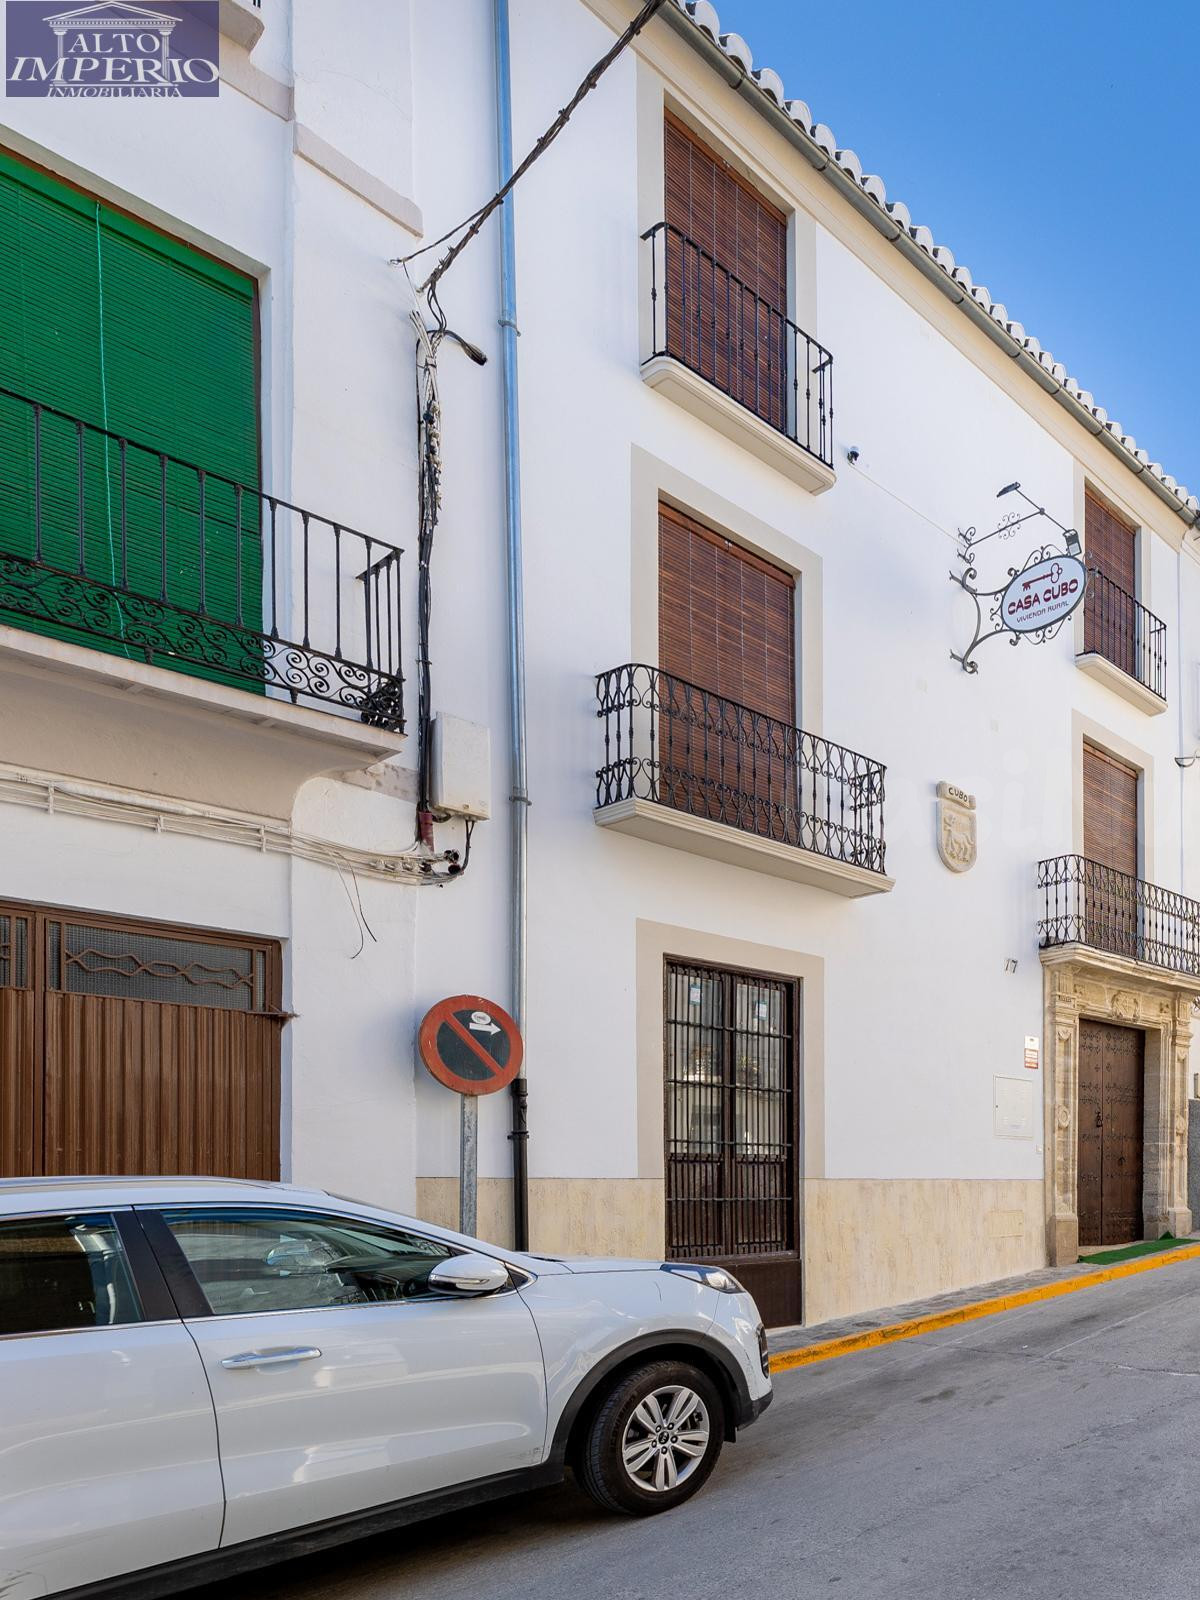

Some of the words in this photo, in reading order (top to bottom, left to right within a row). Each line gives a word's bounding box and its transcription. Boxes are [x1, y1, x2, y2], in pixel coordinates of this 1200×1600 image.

[1008, 593, 1040, 615] CASA
[1043, 578, 1078, 602] CUBO
[1016, 608, 1046, 623] VIVIENDA
[1047, 600, 1069, 612] RURAL
[948, 787, 968, 802] CUBO
[1005, 959, 1018, 973] 17
